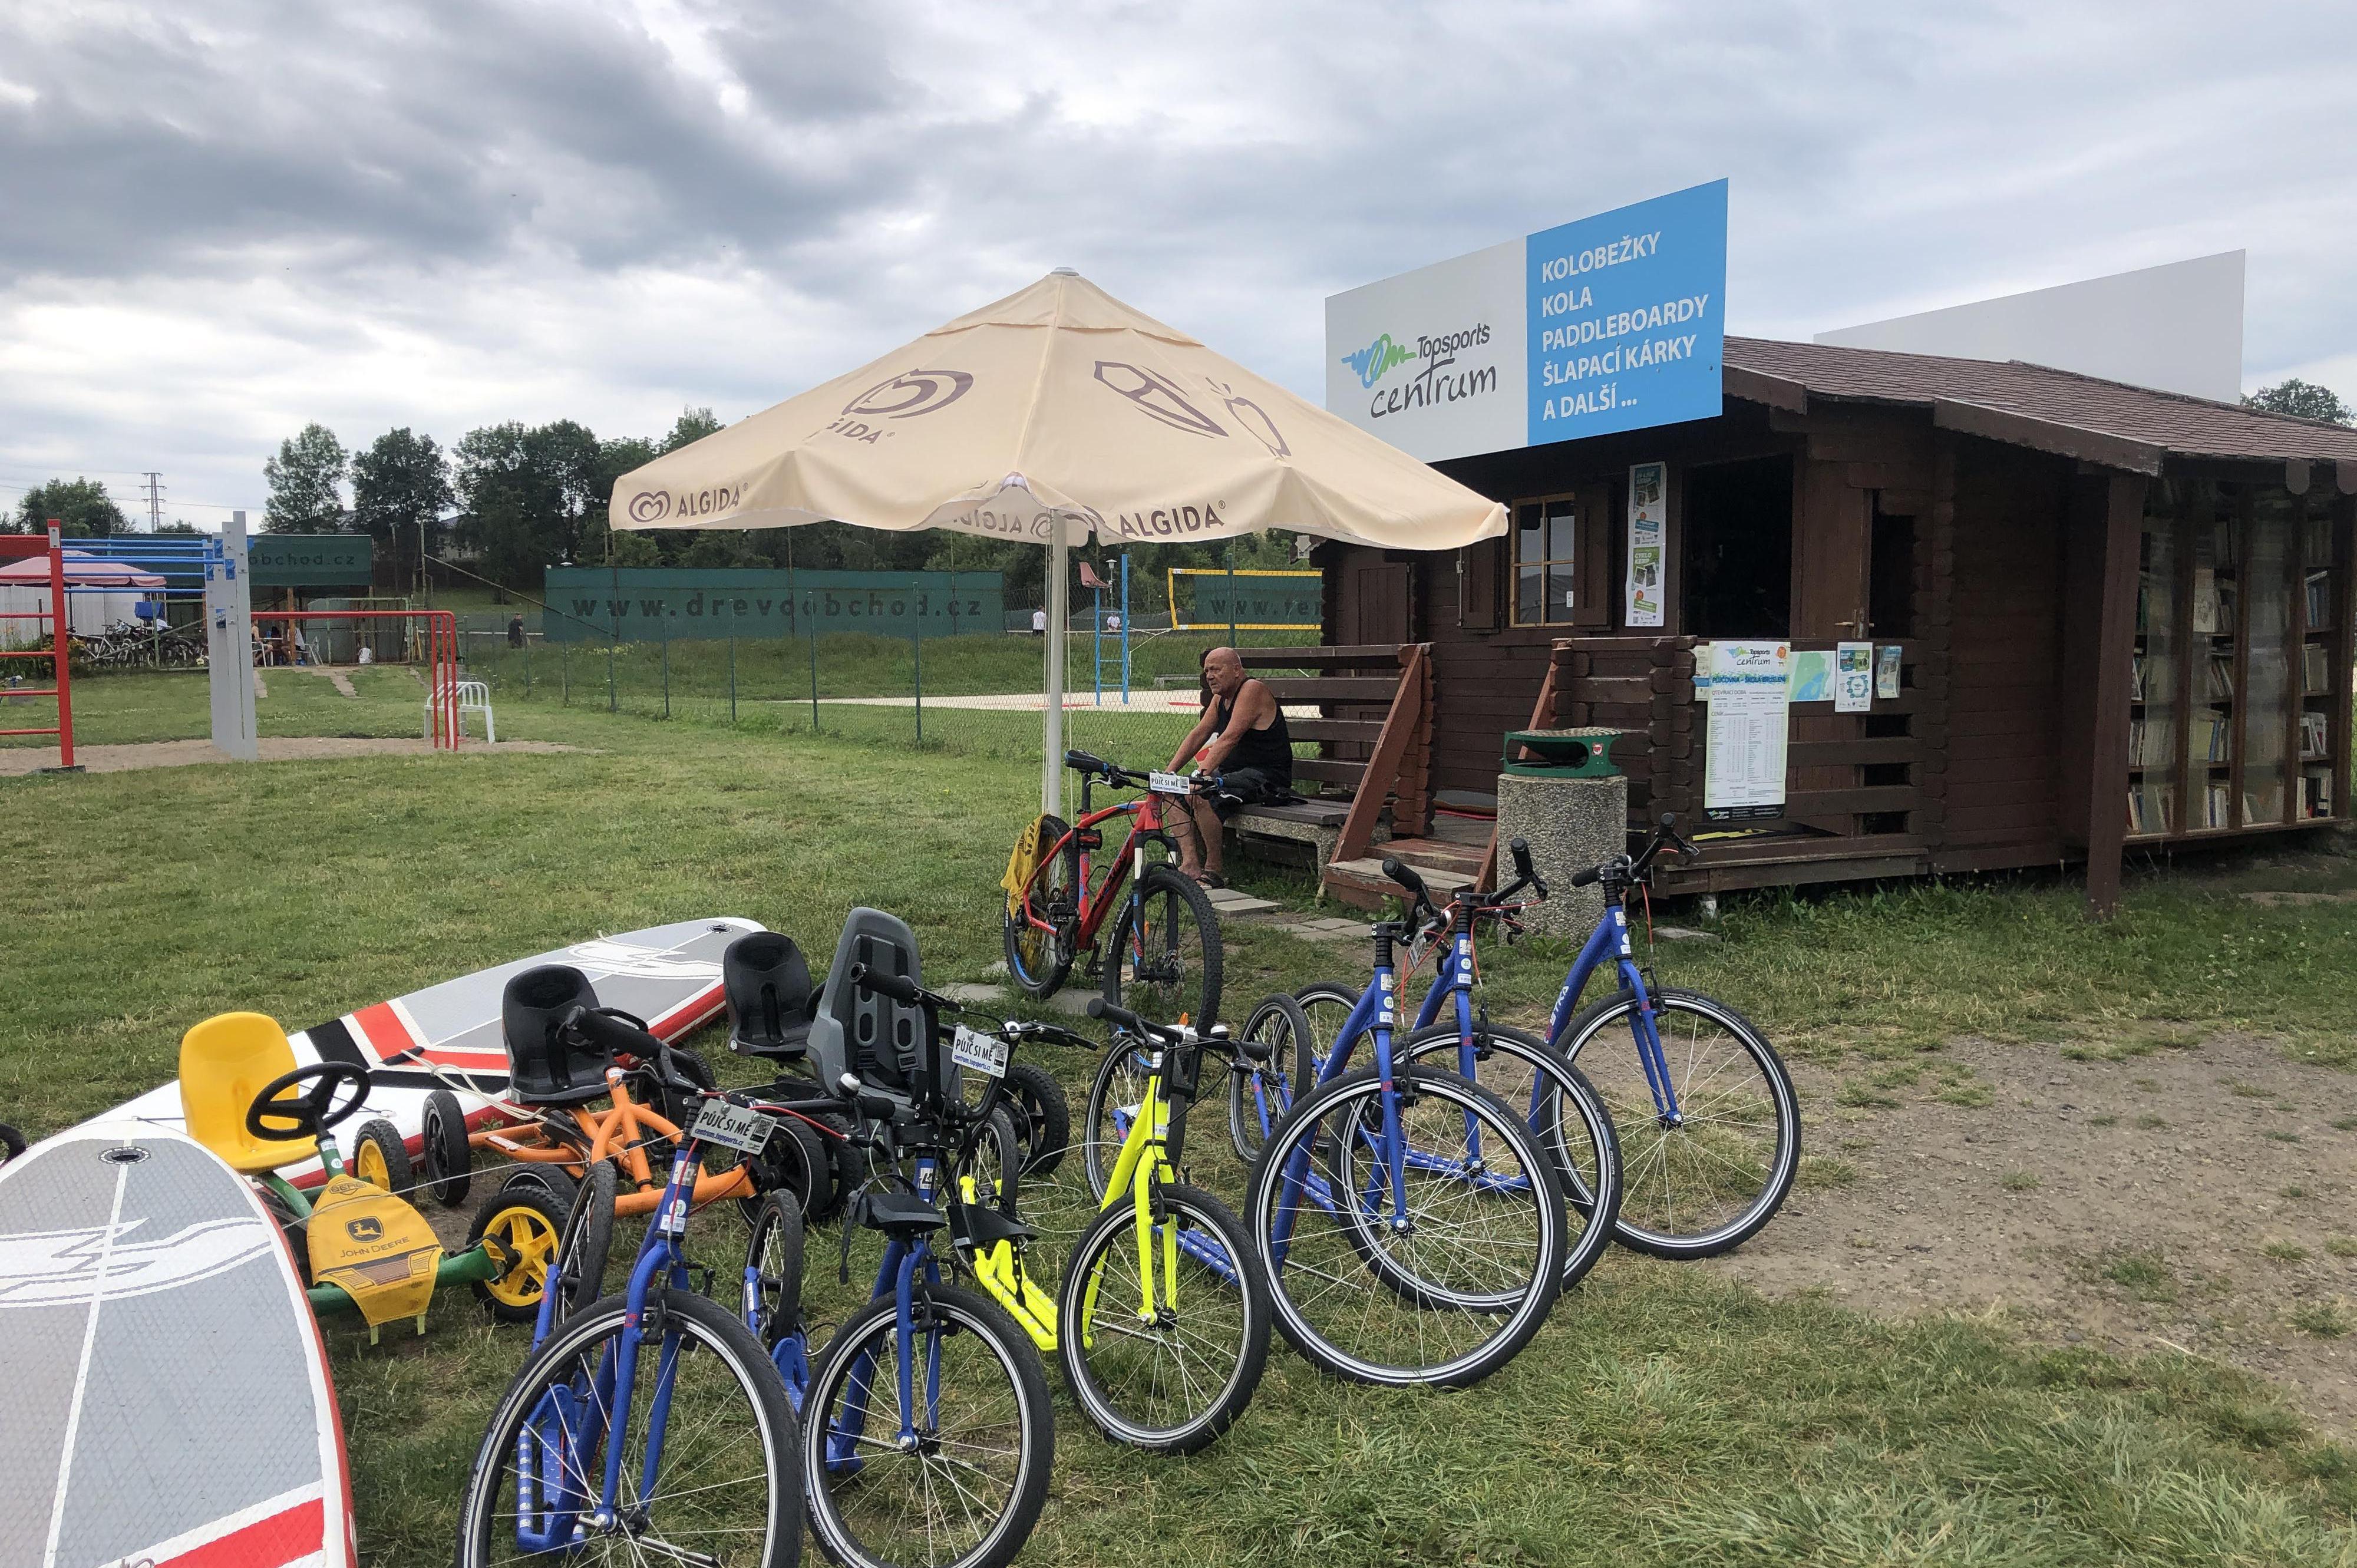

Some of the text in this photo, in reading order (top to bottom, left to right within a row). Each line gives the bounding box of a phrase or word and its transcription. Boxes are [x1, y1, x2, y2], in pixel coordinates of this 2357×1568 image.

[1542, 231, 1661, 283] KOLOBEŽKY
[1542, 287, 1593, 318] KOLA
[1542, 294, 1708, 352] PADDLEBOARDY
[1417, 322, 1490, 361] Topsports
[1543, 334, 1696, 388] ŠLAPACÍ KÁRKY
[1543, 400, 1556, 421] A
[1561, 382, 1618, 419] DALŠÍ
[572, 592, 982, 617] www.drevoobchod.cz
[956, 1038, 974, 1055] PŮJČ
[973, 1045, 981, 1058] SI
[699, 1111, 727, 1129] PŮJČ
[723, 1118, 736, 1132] SI
[340, 1236, 410, 1258] JOHN DEERE
